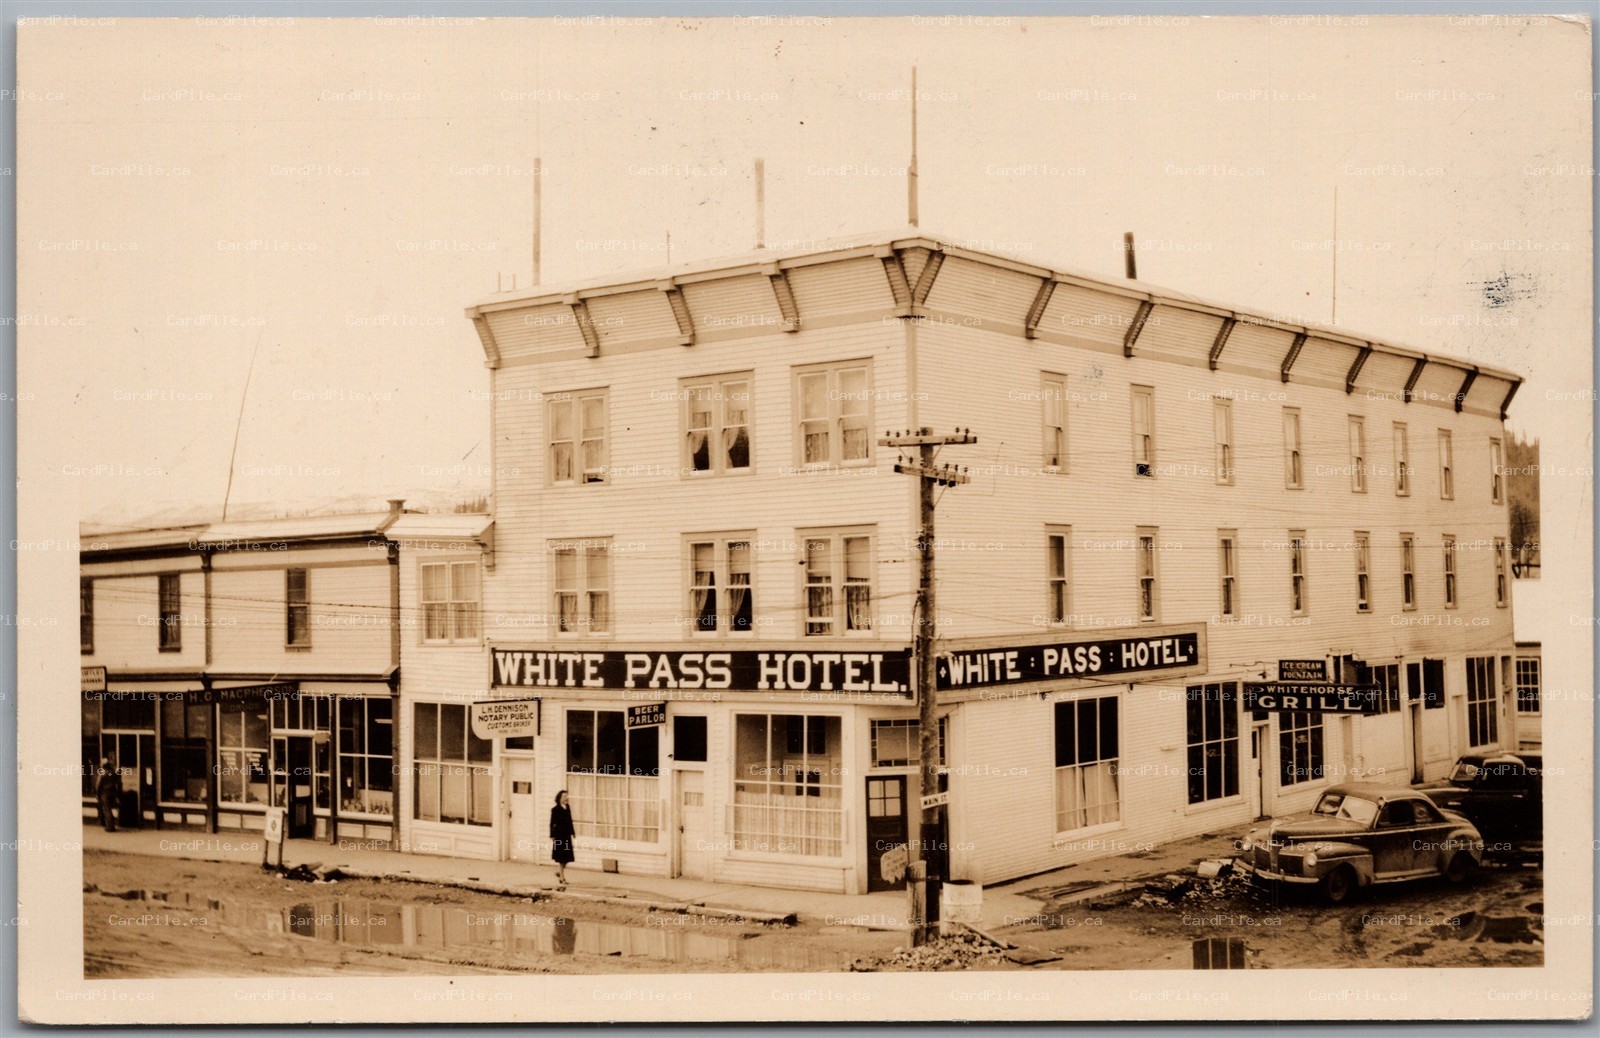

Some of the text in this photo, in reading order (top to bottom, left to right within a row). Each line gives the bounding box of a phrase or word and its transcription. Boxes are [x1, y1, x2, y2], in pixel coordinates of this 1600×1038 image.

[947, 651, 1021, 685] WHITE
[1043, 645, 1102, 675] PASS
[1121, 638, 1188, 668] HOTEL
[1282, 661, 1322, 670] ICE CREAM
[495, 653, 907, 692] WHITE PASS HOTEL.
[1283, 671, 1323, 679] FOUNTAIN
[1266, 685, 1354, 695] WHITEHORSE
[1258, 695, 1362, 711] GRILL
[494, 704, 529, 713] DENNISON
[634, 705, 659, 715] BEER
[478, 712, 534, 722] NOTARY PUBLIC
[629, 713, 665, 725] PARLOR
[487, 721, 512, 730] CUSTOMS
